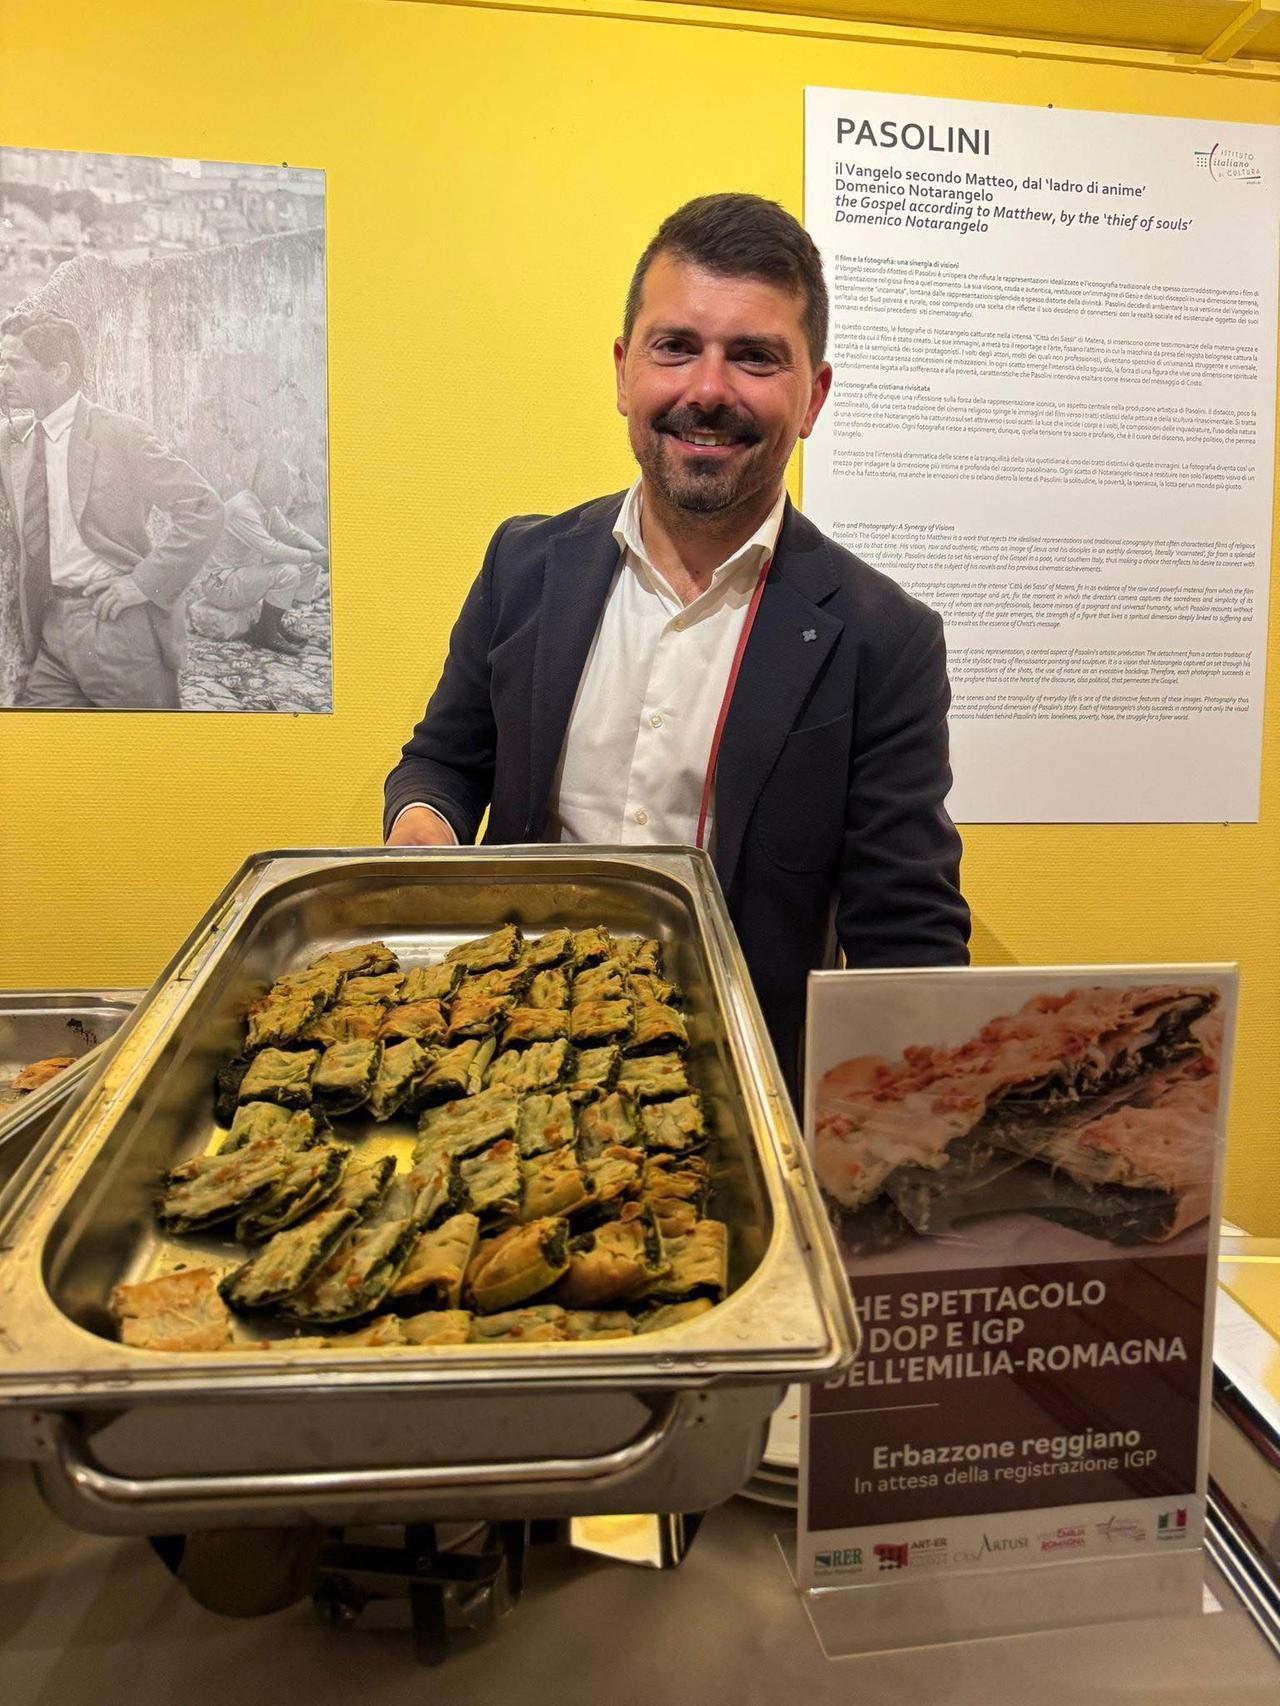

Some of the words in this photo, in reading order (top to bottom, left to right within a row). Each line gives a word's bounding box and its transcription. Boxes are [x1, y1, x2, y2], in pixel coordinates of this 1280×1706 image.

[837, 117, 989, 155] PASOLINI
[835, 162, 842, 174] il
[845, 162, 902, 183] Vangelo
[905, 167, 961, 184] secondo
[965, 173, 1017, 190] Matteo,
[1022, 176, 1041, 189] dal
[1086, 180, 1098, 194] di
[835, 178, 904, 195] Domenico
[909, 183, 993, 205] Notarangelo
[835, 194, 857, 207] the
[861, 195, 905, 215] Gospel
[909, 199, 972, 219] according
[977, 206, 989, 217] to
[993, 205, 1055, 224] Matthew,
[1060, 210, 1074, 226] by
[1078, 211, 1099, 224] the
[1140, 215, 1154, 231] of
[835, 210, 901, 226] Domenico
[905, 214, 988, 235] Notarangelo
[900, 1279, 1106, 1319] SPETTACOLO
[869, 1323, 938, 1354] DOP
[946, 1321, 963, 1348] E
[972, 1317, 1025, 1345] IGP
[872, 1441, 1015, 1470] Erbazzone
[1021, 1427, 1141, 1459] reggiano
[854, 1476, 872, 1494] In
[877, 1472, 939, 1492] attesa
[944, 1465, 989, 1485] della
[994, 1454, 1119, 1483] registrazione
[1123, 1449, 1158, 1469] IGP
[833, 1548, 863, 1566] RER
